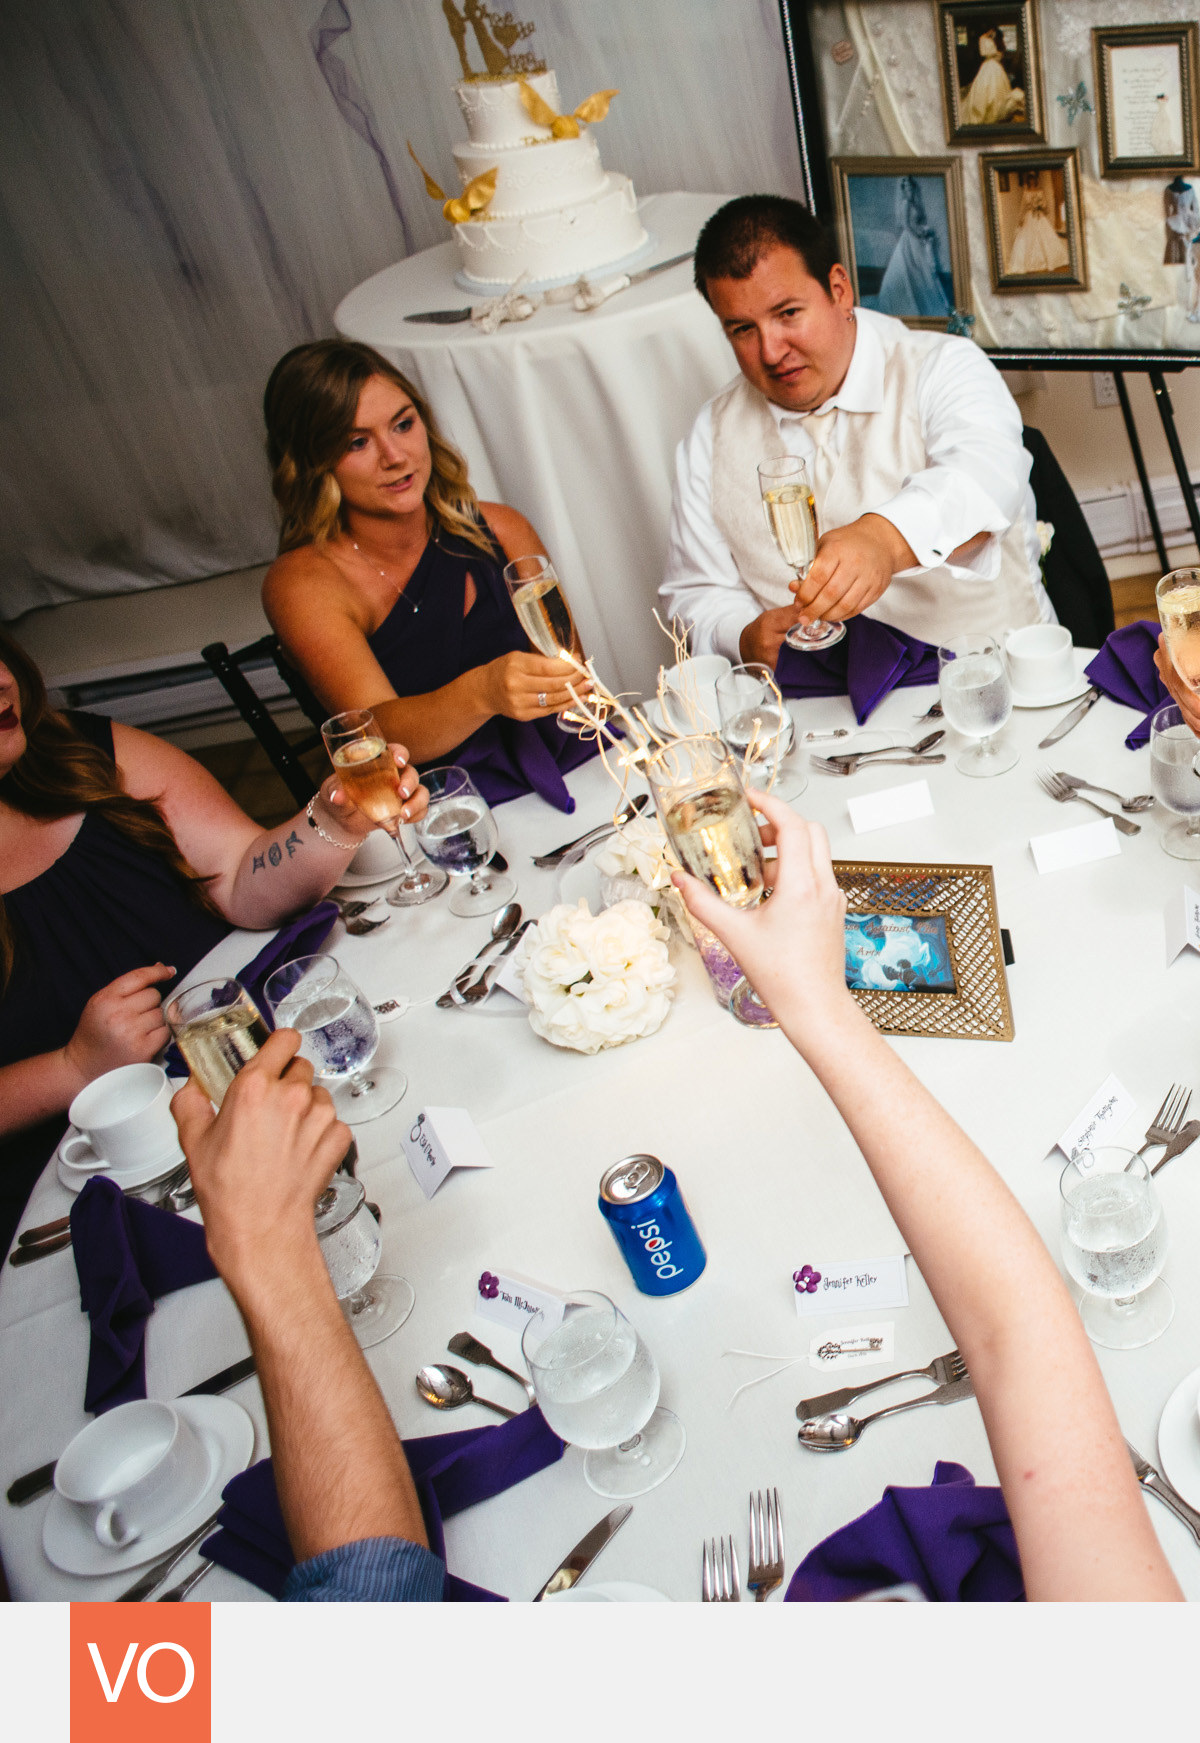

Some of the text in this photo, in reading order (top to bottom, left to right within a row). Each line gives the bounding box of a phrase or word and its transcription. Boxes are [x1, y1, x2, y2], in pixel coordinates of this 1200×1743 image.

[864, 921, 911, 934] Against
[915, 921, 939, 934] The
[631, 1219, 684, 1280] pepsi
[823, 1277, 853, 1291] Jennifer
